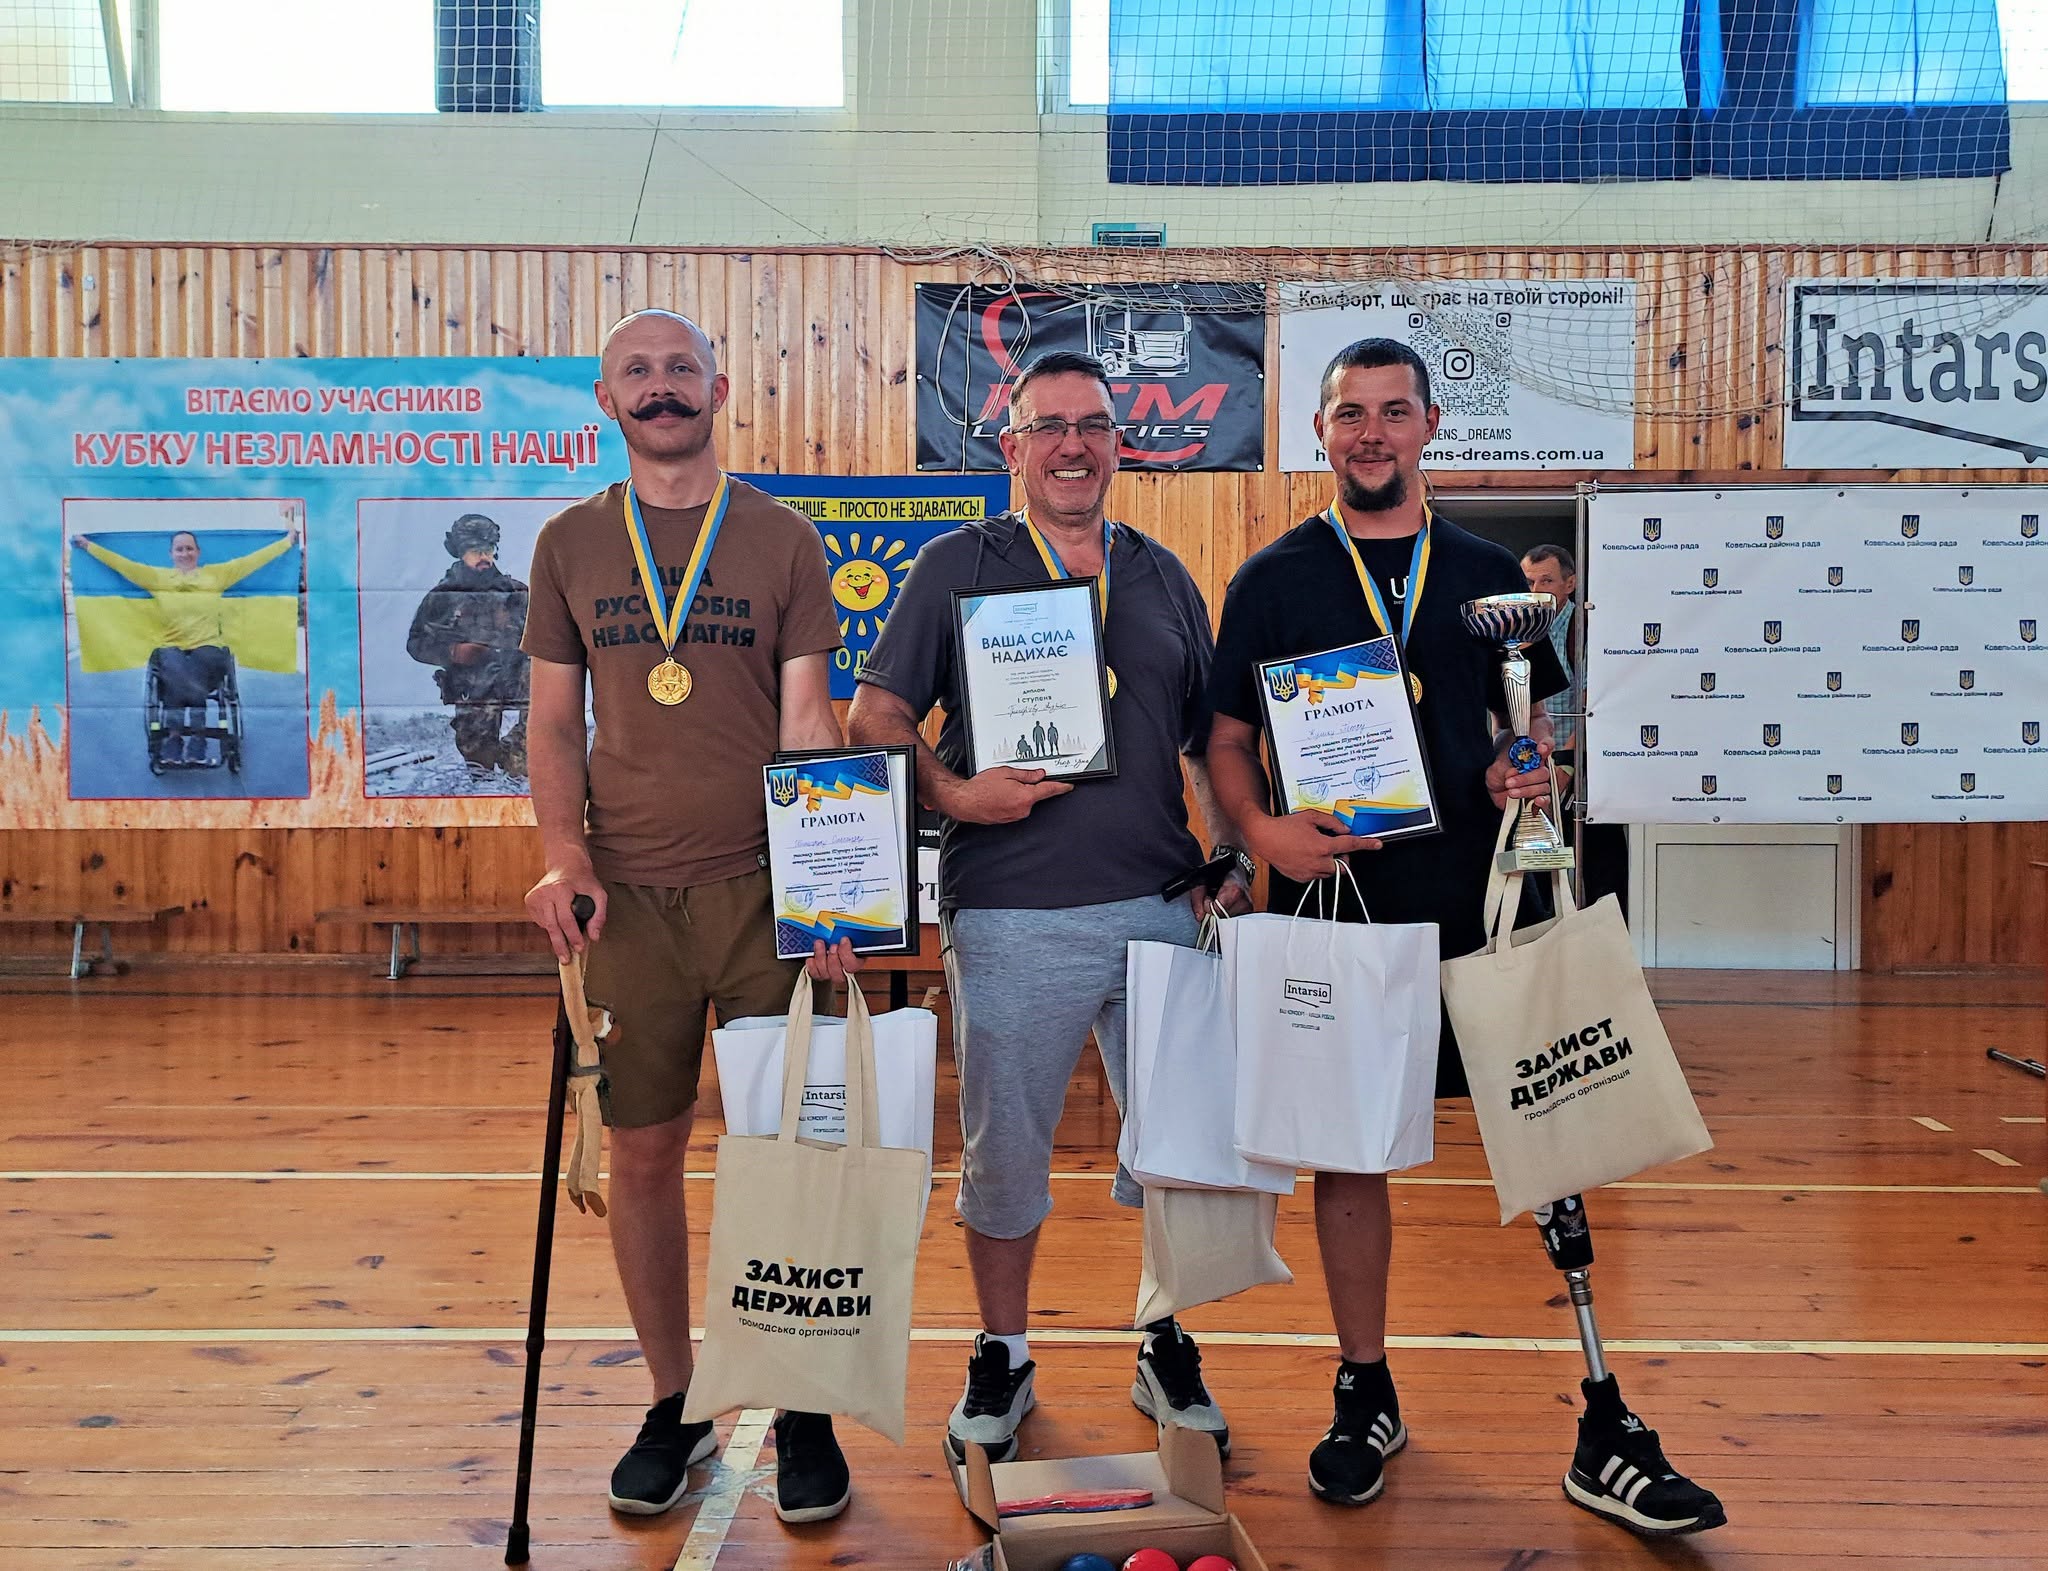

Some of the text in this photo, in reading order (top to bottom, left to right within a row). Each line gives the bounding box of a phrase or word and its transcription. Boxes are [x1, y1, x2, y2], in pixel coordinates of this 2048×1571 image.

[1299, 290, 1384, 310] Комфорт,
[1468, 292, 1488, 305] на
[1494, 288, 1542, 305] твоїй
[1548, 287, 1623, 308] стороні!
[1807, 313, 2048, 403] Intars
[186, 387, 482, 413] ВІТАЄМО УЧАСНИКІВ
[74, 424, 600, 472] КУБКУ НЕЗЛАМНОСТІ НАЦІЇ
[839, 501, 888, 518] ПРОСТО
[890, 501, 906, 517] НЕ
[908, 500, 980, 520] ЗДАВАТИСЬ!
[1602, 543, 1644, 551] Ковельська
[1646, 542, 1678, 552] районна
[1724, 540, 1820, 549] Ковельська районна рада
[1863, 539, 1957, 548] Ковельська районна рада
[592, 623, 757, 648] НЕДОТАТНЯ
[981, 628, 1076, 650] ВАША СИЛА
[991, 645, 1069, 665] НАДИХАЄ
[1603, 645, 1699, 656] Ковельська районна рада
[1724, 645, 1767, 654] Ковельська
[1768, 645, 1800, 654] районна
[1861, 644, 1959, 653] Ковельська районна рада
[1303, 698, 1375, 722] ГРАМОТА
[1602, 749, 1698, 758] Ковельська районна рада
[1723, 748, 1766, 756] Ковельська
[1768, 748, 1800, 757] районна
[1861, 747, 1905, 755] Ковельська
[1906, 747, 1938, 755] районна
[800, 811, 866, 829] ГРАМОТА
[1287, 984, 1328, 998] Intarsio
[1515, 1017, 1613, 1079] ЗАХИСТ
[1510, 1036, 1633, 1111] ДЕРЖАВИ
[1524, 1068, 1631, 1121] громадська організація
[745, 1259, 864, 1290] ЗАХИСТ
[731, 1285, 872, 1318] ДЕРЖАВИ
[738, 1317, 860, 1338] громадська організація
